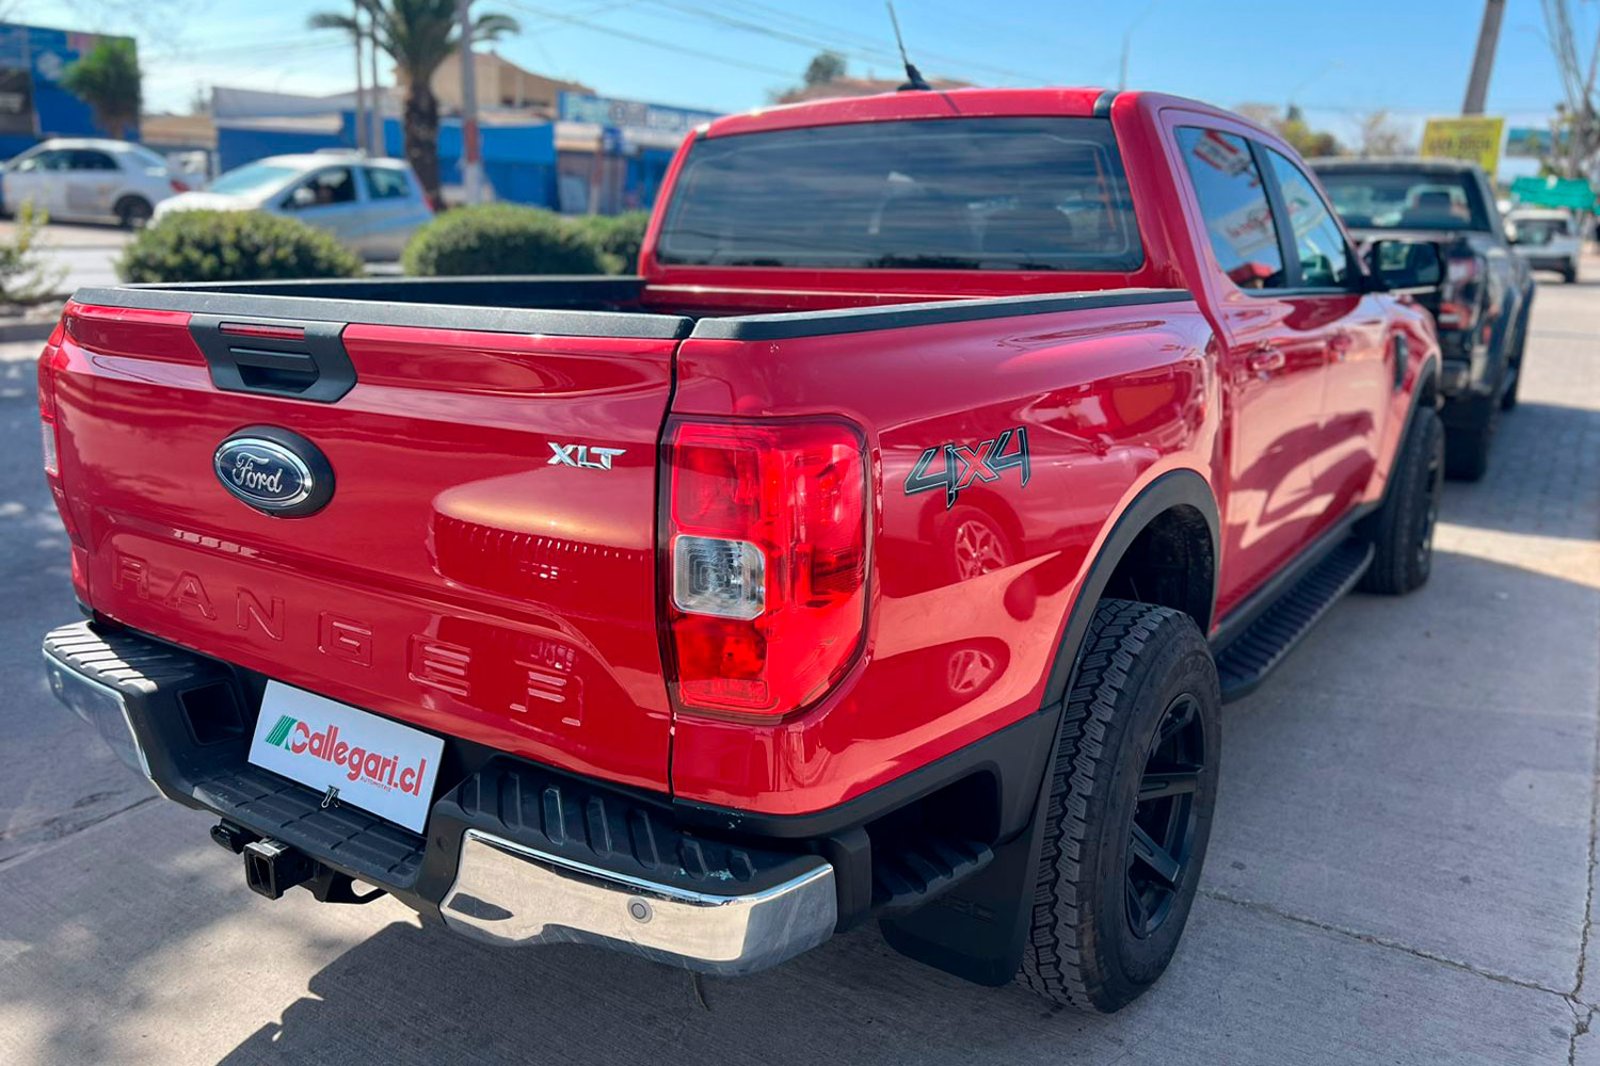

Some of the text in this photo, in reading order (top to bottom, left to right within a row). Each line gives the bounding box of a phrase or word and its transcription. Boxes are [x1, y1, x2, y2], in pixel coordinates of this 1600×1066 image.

[232, 452, 283, 494] Ford
[547, 441, 627, 471] XLT
[113, 554, 583, 727] RANGER
[288, 721, 427, 797] Callegari.cl
